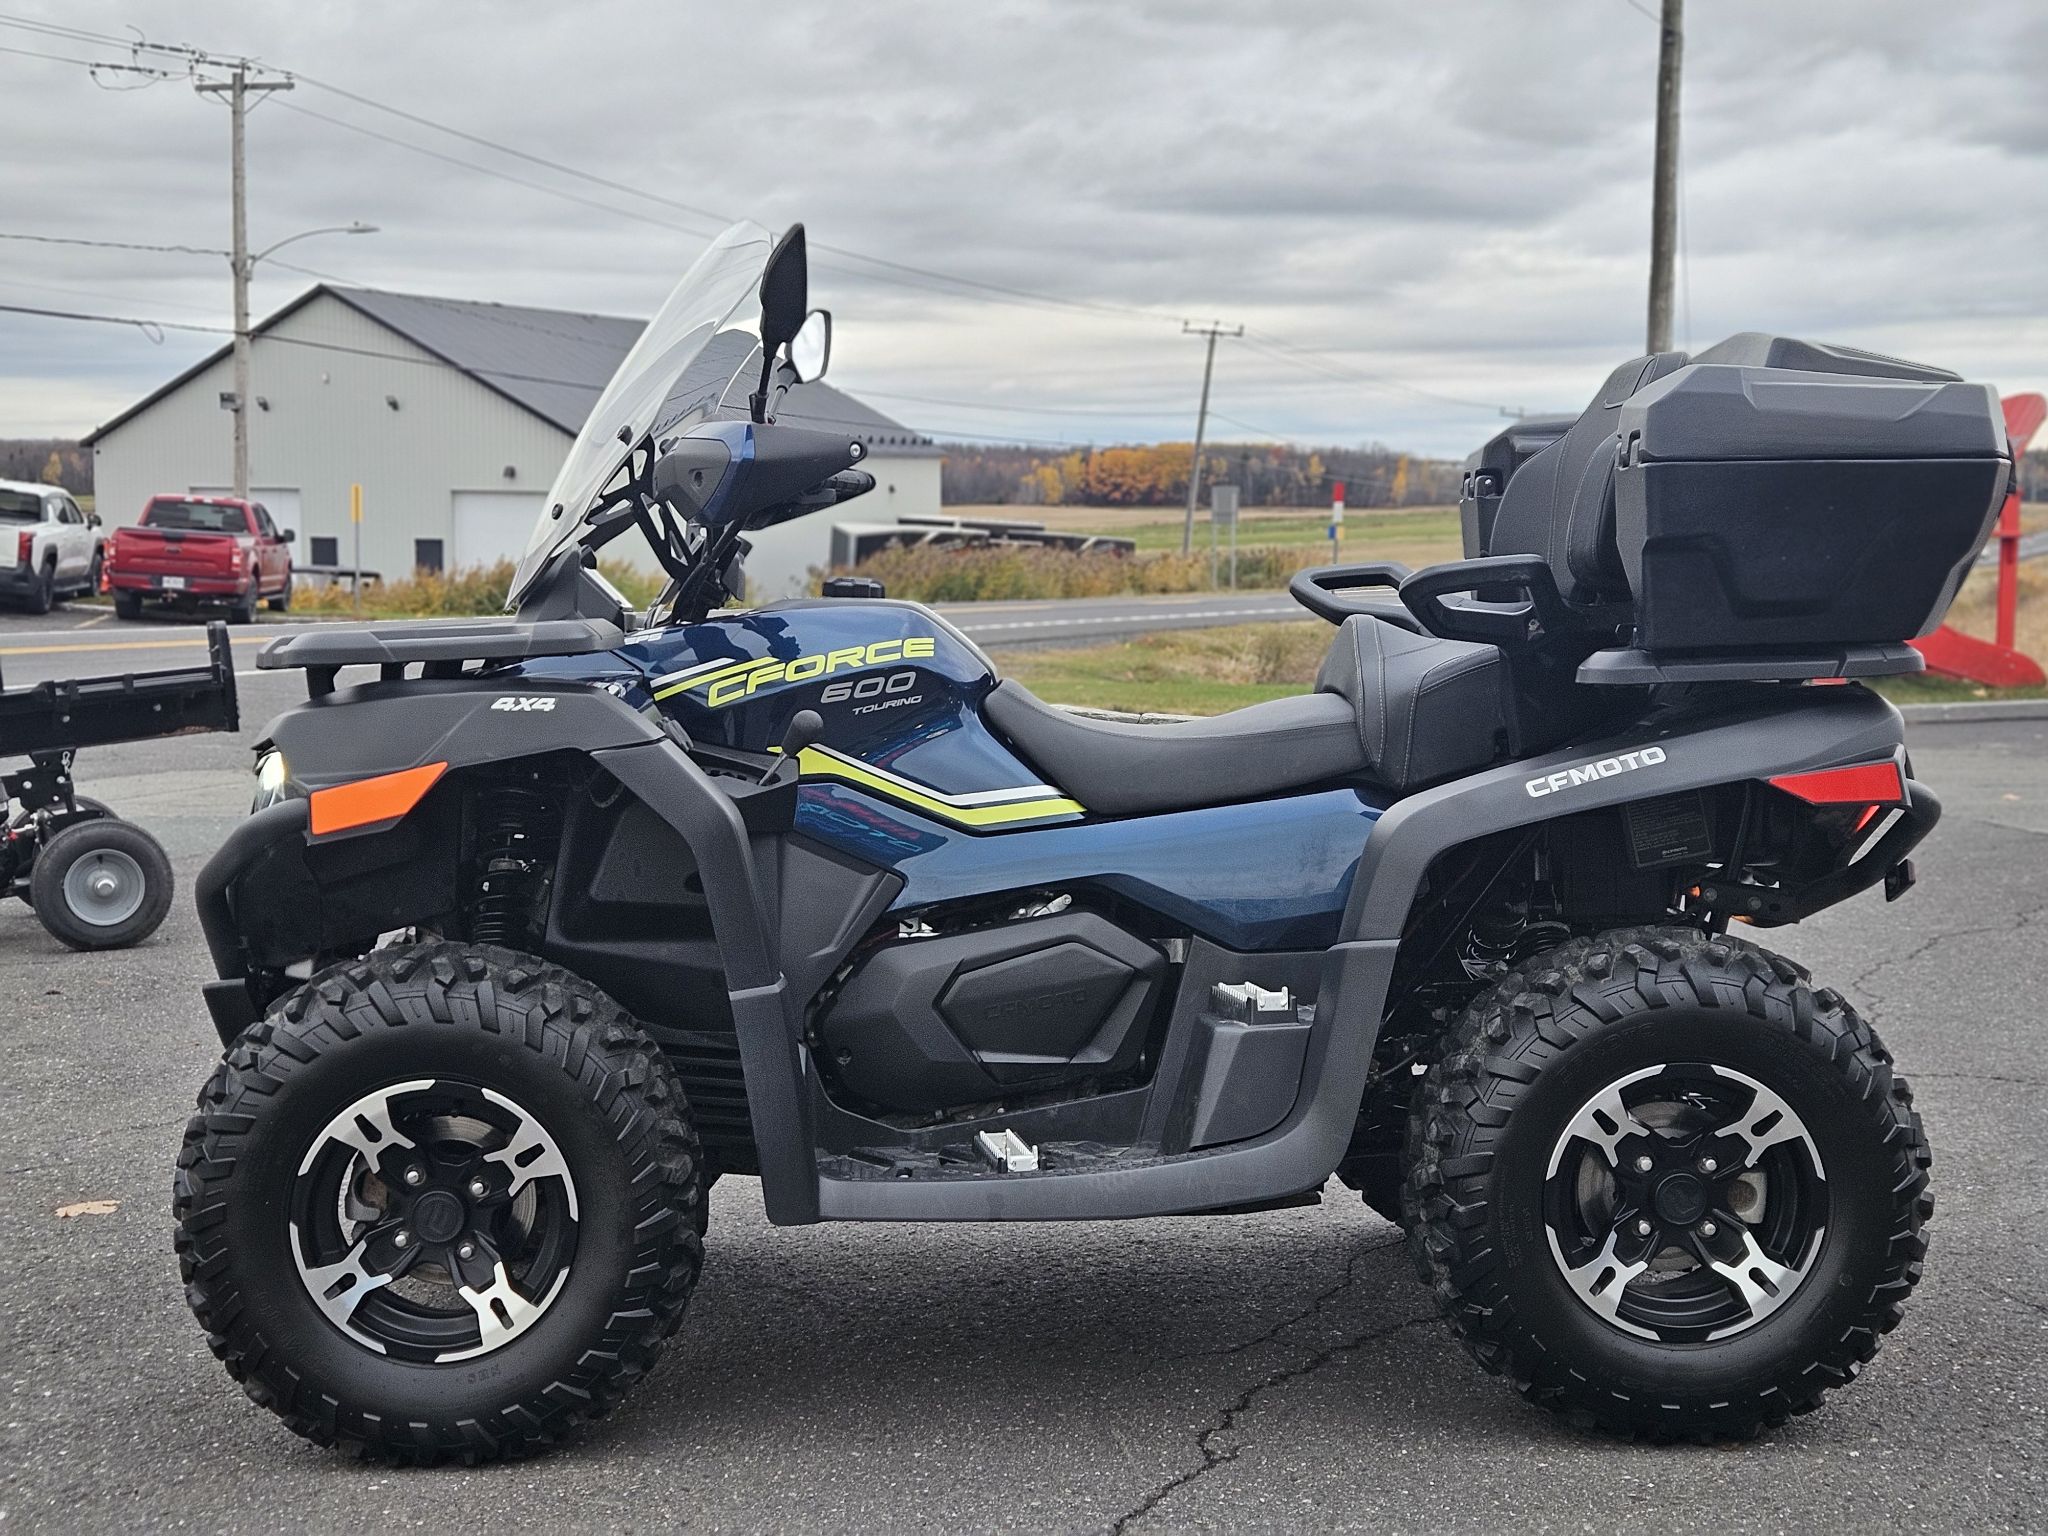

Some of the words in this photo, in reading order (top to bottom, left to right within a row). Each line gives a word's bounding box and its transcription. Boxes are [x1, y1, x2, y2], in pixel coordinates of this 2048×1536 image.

[708, 637, 935, 708] CFORCE
[820, 671, 917, 704] 600
[490, 697, 556, 712] 4X4
[852, 695, 923, 715] TOURING
[1525, 746, 1667, 798] CFMOTO
